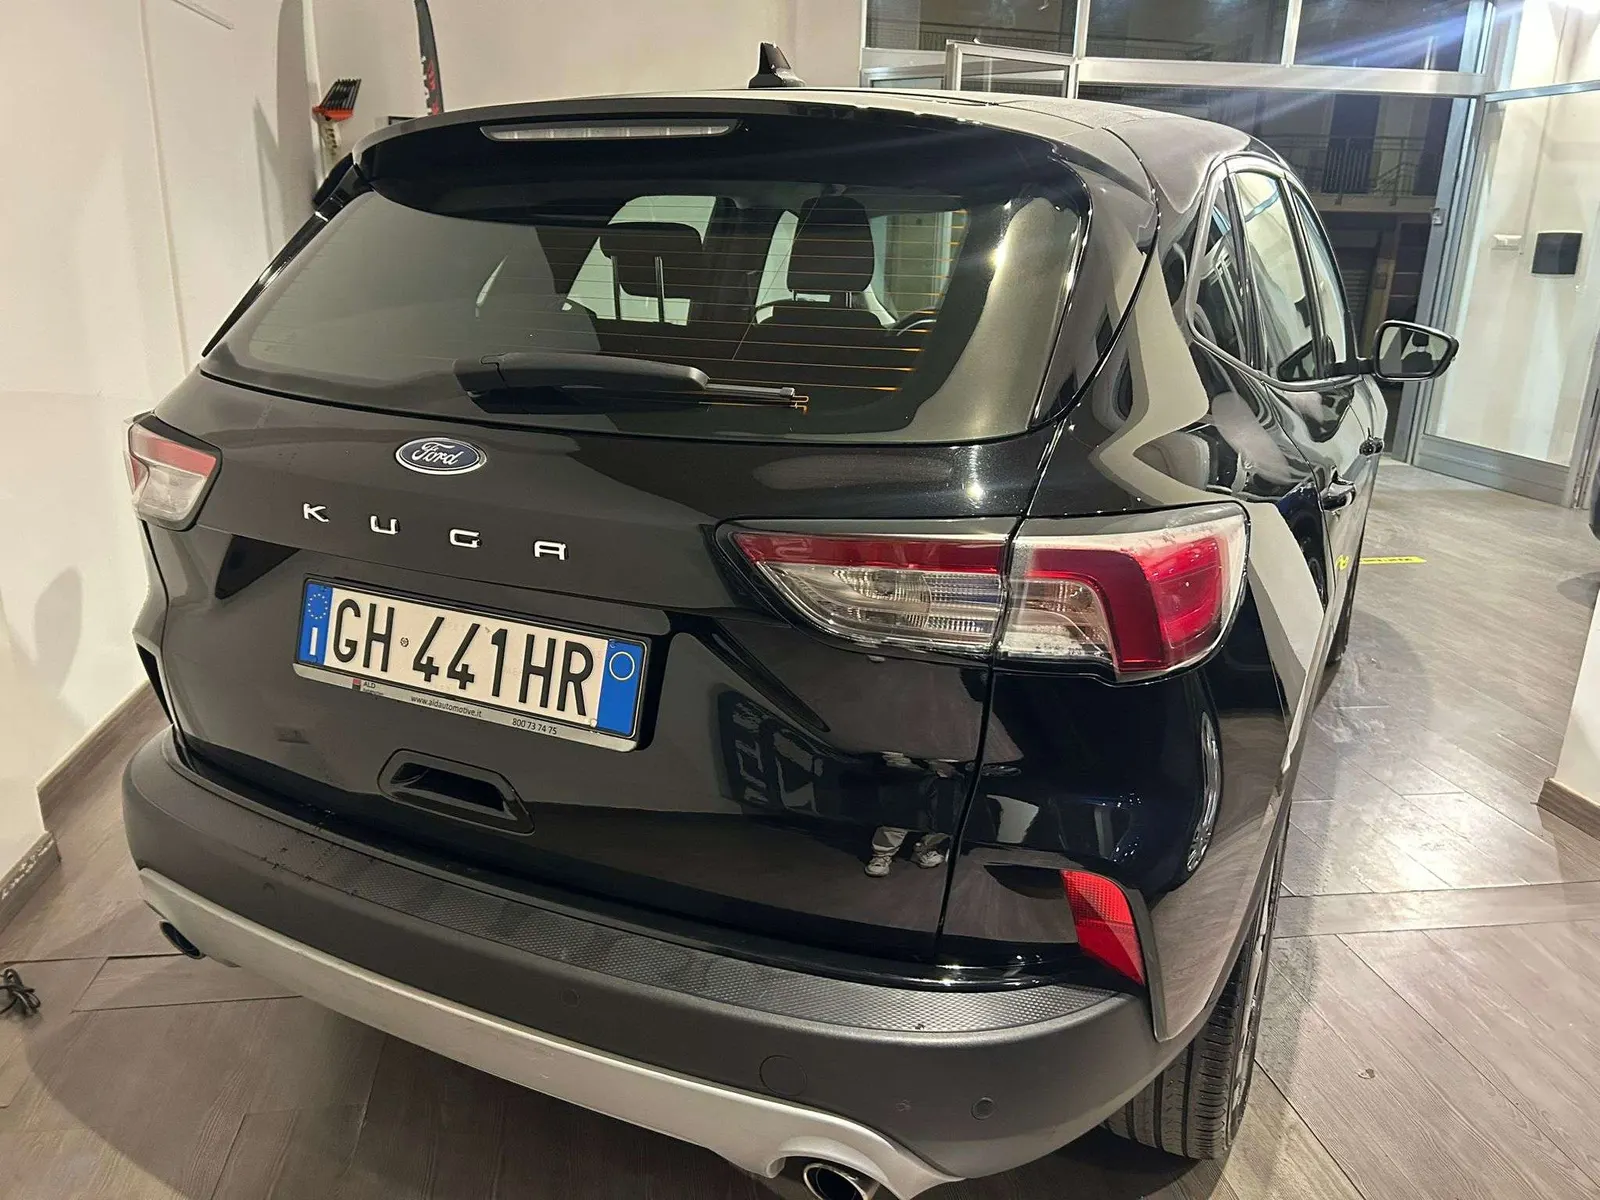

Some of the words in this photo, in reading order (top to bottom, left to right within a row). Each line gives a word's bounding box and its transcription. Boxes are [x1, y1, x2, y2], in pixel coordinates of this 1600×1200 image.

[411, 441, 464, 466] Ford
[303, 503, 567, 560] KUGA
[333, 599, 395, 672] GH
[363, 681, 376, 689] ALD
[411, 695, 482, 718] www.aldautomotive.it
[512, 717, 526, 728] 800
